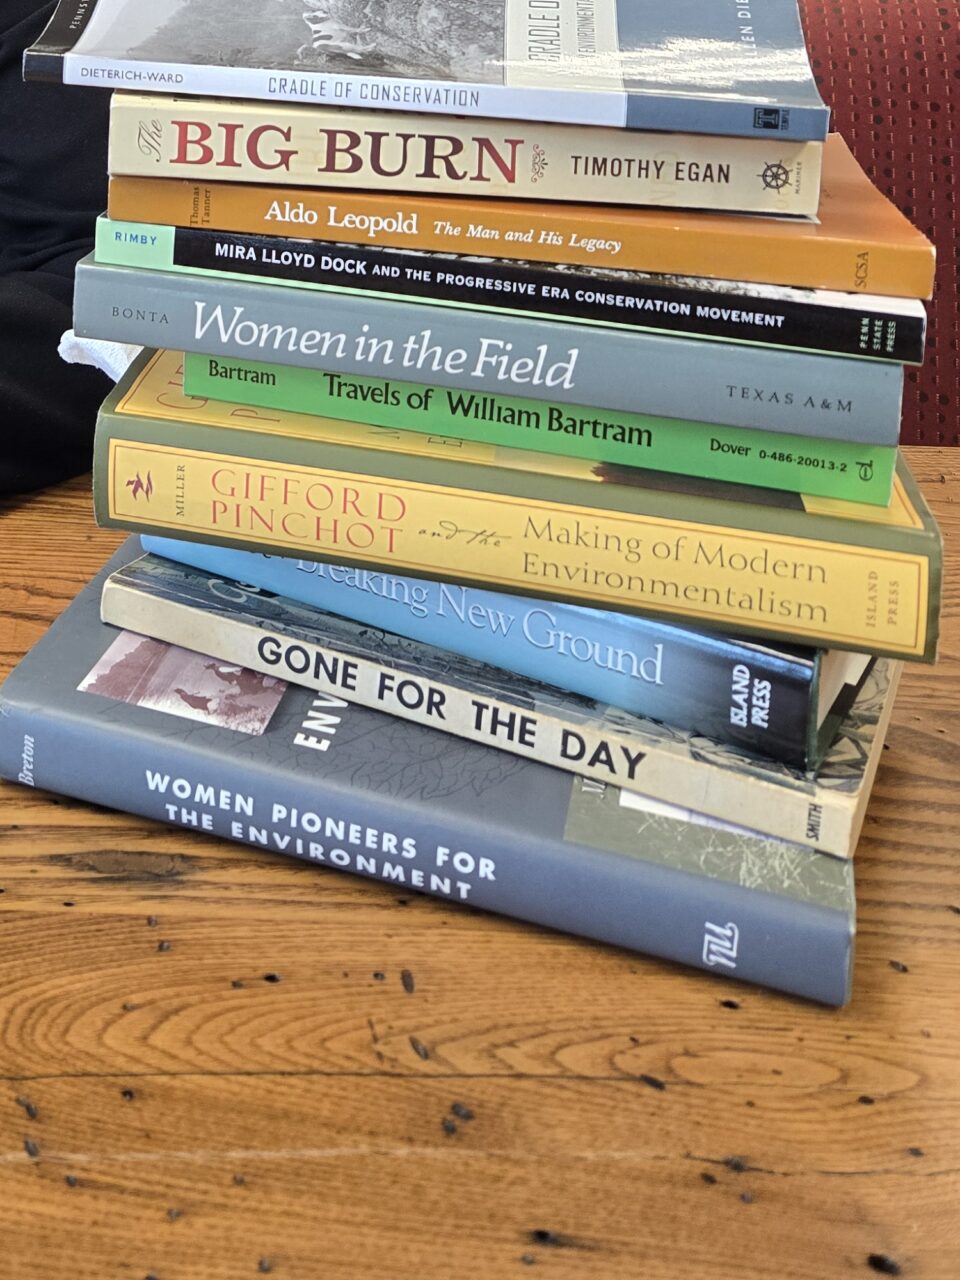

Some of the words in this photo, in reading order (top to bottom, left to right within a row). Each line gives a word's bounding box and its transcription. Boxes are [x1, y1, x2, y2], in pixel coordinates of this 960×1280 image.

[528, 13, 561, 62] CRADLE
[740, 26, 758, 57] LLEN
[80, 67, 184, 84] DIETERICH-WARD
[268, 76, 327, 97] CRADLE
[334, 80, 353, 98] OF
[359, 83, 481, 107] CONSERVATION
[136, 118, 163, 162] The
[169, 120, 299, 172] BIG
[318, 128, 525, 184] BURN
[571, 155, 666, 180] TIMOTHY
[675, 162, 731, 184] EGAN
[188, 186, 200, 226] Thomas
[202, 188, 212, 225] Tanner
[263, 200, 318, 225] Aldo
[327, 206, 419, 238] Leopold
[114, 231, 157, 246] RIMBY
[433, 221, 462, 237] The
[466, 224, 500, 240] Man
[504, 228, 534, 244] and
[537, 230, 564, 246] His
[568, 233, 622, 254] Legacy
[215, 242, 257, 262] MIRA
[262, 248, 316, 269] LLOYD
[321, 255, 368, 276] DOCK
[372, 264, 400, 278] AND
[404, 267, 432, 283] THE
[436, 272, 536, 296] PROGRESSIVE
[542, 285, 570, 300] ERA
[575, 290, 691, 316] CONSERVATION
[696, 305, 785, 329] MOVEMENT
[854, 251, 870, 289] SCSA
[111, 306, 170, 324] BONTA
[859, 317, 870, 349] PENN
[873, 319, 883, 351] STATE
[886, 321, 897, 352] PRESS
[193, 301, 347, 358] Women
[354, 324, 395, 365] in
[402, 329, 467, 375] the
[471, 337, 580, 390] Field
[208, 359, 277, 386] Bartram
[726, 385, 795, 406] TEXAS
[323, 372, 401, 407] Travels
[406, 388, 435, 411] of
[446, 391, 541, 430] William
[547, 407, 654, 448] Bartram
[710, 438, 752, 457] Dover
[759, 449, 848, 473] 0-486-20013-2
[176, 464, 186, 517] MILLER
[211, 468, 407, 522] GIFFORD
[211, 500, 404, 553] PINCHOT
[418, 521, 460, 541] and
[464, 528, 512, 548] the
[523, 515, 642, 563] Making
[651, 535, 687, 562] of
[693, 541, 828, 585] Modern
[522, 552, 829, 624] Environmentalism
[865, 570, 879, 629] ISLAND
[887, 580, 900, 626] PRESS
[436, 583, 515, 638] New
[523, 608, 664, 687] Ground
[257, 636, 359, 692] GONE
[377, 671, 447, 720] FOR
[471, 699, 538, 749] THE
[559, 729, 647, 780] DAY
[730, 664, 751, 729] ISLAND
[751, 678, 772, 729] PRESS
[17, 734, 36, 788] Breton
[145, 770, 255, 817] WOMEN
[272, 803, 417, 860] PIONEERS
[436, 845, 497, 881] FOR
[806, 802, 823, 842] SMITH
[165, 803, 214, 831] THE
[231, 821, 472, 900] ENVIRONMENT
